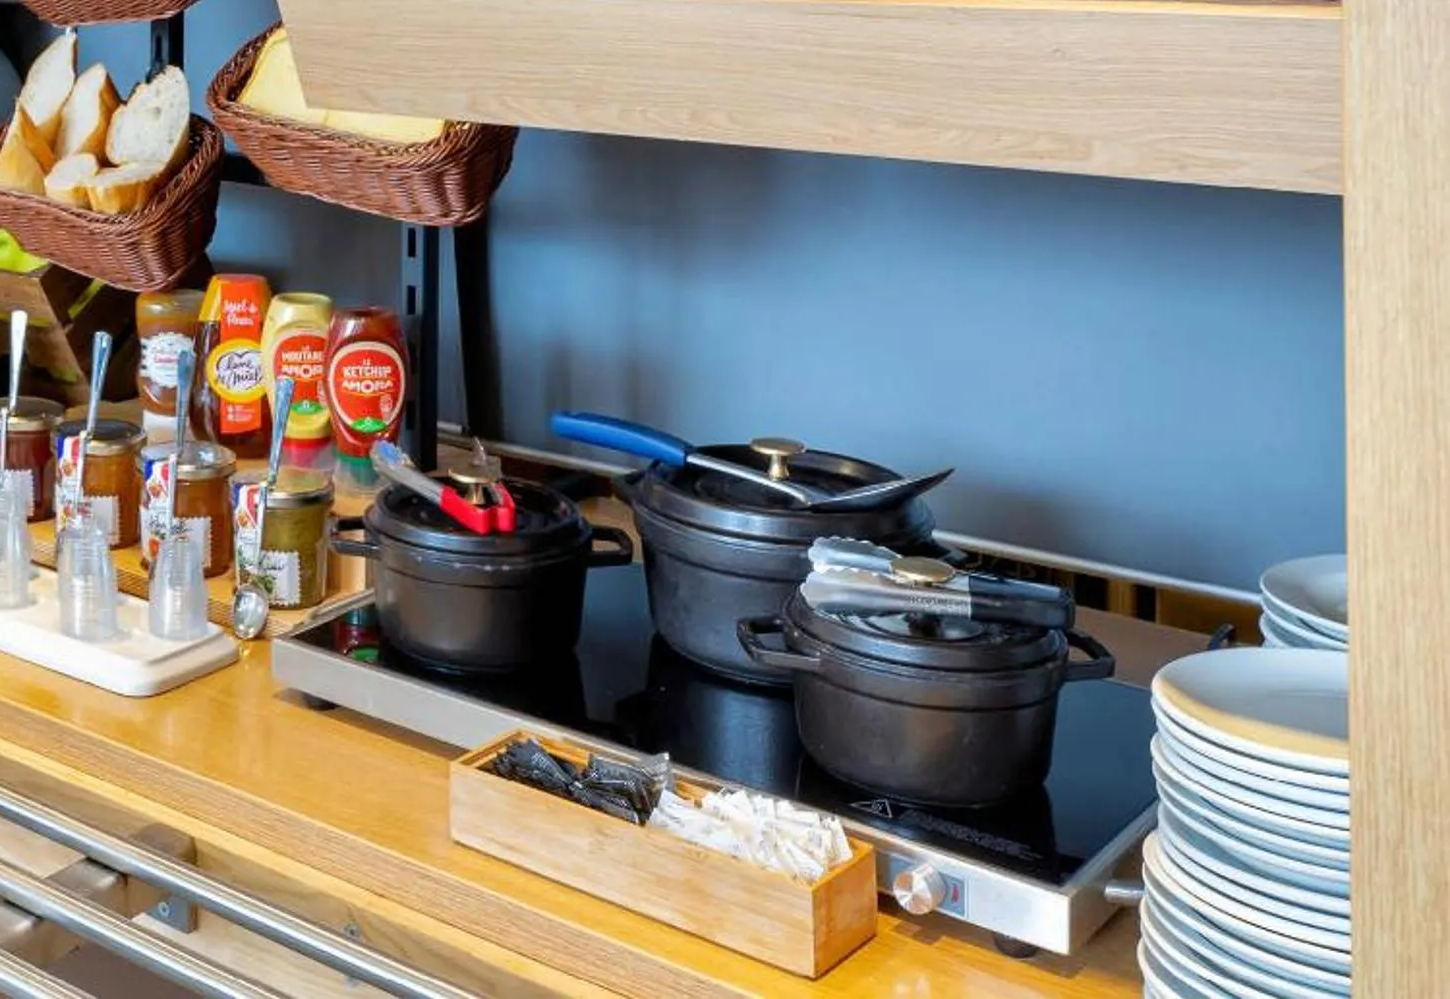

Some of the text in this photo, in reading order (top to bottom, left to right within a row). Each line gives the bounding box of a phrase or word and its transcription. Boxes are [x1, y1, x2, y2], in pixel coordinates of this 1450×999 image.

[281, 364, 323, 378] AMOR
[342, 365, 392, 379] KETCHUP
[342, 379, 394, 394] AMORA
